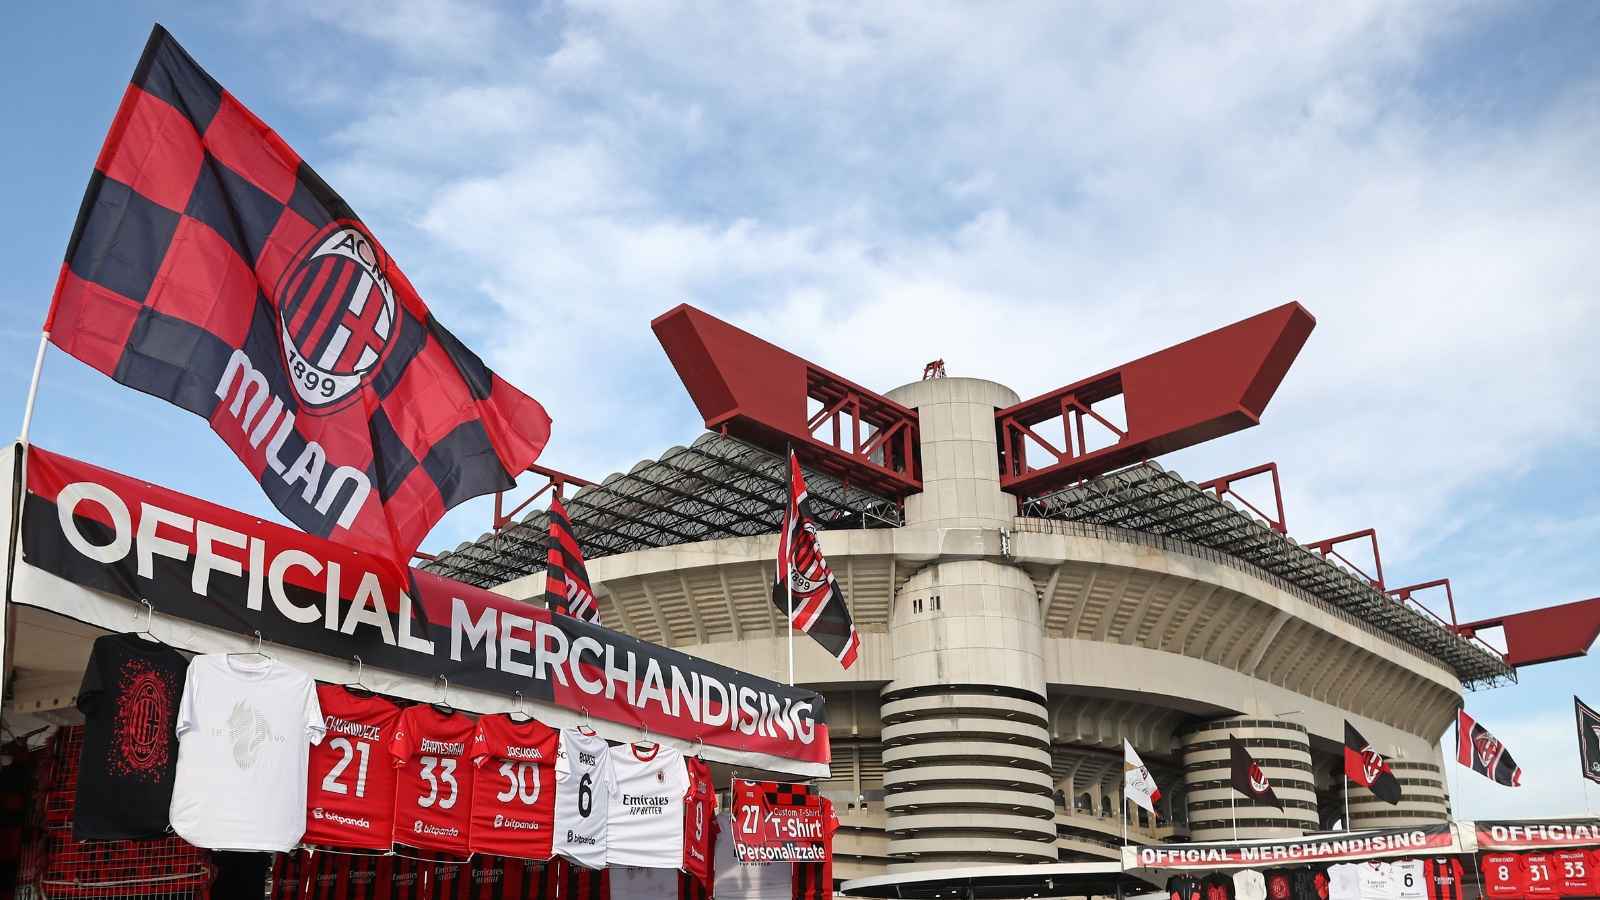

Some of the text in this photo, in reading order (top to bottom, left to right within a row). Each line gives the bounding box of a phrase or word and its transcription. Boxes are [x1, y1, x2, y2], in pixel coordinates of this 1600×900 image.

[289, 351, 337, 398] 1899
[215, 349, 371, 530] MILAN
[57, 481, 815, 744] OFFICIAL MERCHANDISING
[421, 738, 465, 756] BARTESAGHI
[322, 737, 371, 797] 21
[417, 756, 458, 809] 33
[497, 762, 540, 805] 30
[578, 773, 592, 818] 6
[622, 794, 669, 806] Emirates
[641, 806, 662, 815] BETTER
[773, 807, 798, 817] Custom
[325, 812, 370, 829] bitpanda
[504, 818, 539, 830] bitpanda
[742, 805, 760, 834] 27
[771, 818, 822, 838] T-Shirt
[423, 825, 459, 837] bitpanda
[1491, 824, 1600, 841] OFFICIAL
[737, 843, 825, 860] Personalizzate
[1141, 831, 1427, 866] OFFICIAL MERCHANDISING
[1498, 865, 1509, 881] 8
[1529, 864, 1549, 881] 31
[1564, 861, 1585, 878] 33
[1404, 873, 1414, 887] 6
